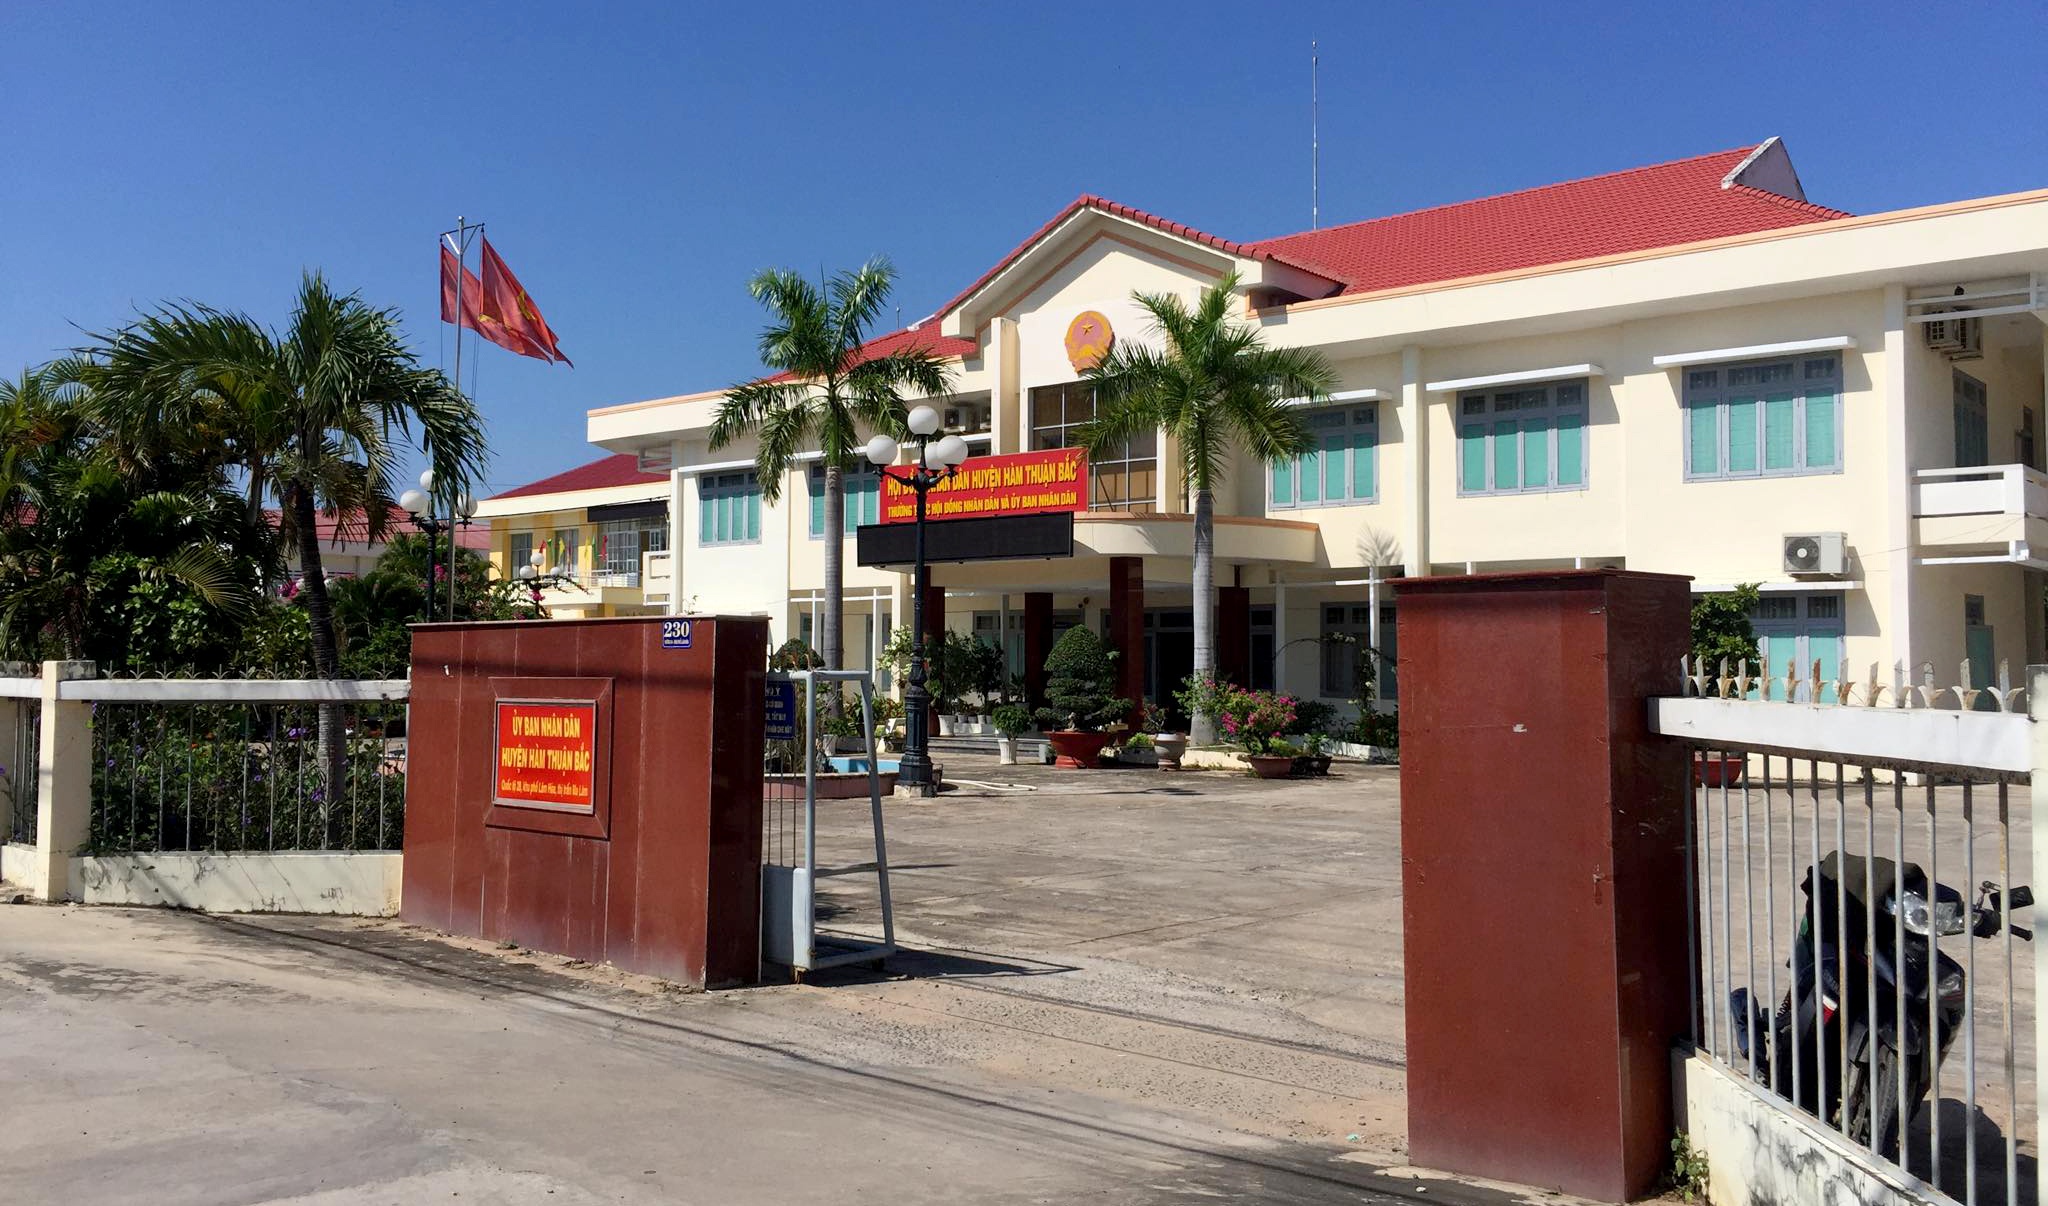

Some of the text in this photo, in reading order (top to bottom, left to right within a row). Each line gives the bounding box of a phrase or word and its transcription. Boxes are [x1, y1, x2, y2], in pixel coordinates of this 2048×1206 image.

[972, 464, 1001, 492] HUYỆN
[1004, 462, 1023, 487] HÀM
[1025, 459, 1056, 488] THUẬN
[1058, 453, 1077, 482] BẮC
[888, 502, 912, 518] THƯỜNG
[931, 500, 943, 518] HỘI
[944, 497, 962, 515] ĐỒNG
[964, 497, 983, 512] NHÂN
[984, 496, 999, 511] DÂN
[1001, 494, 1009, 509] VÀ
[1022, 495, 1037, 508] BAN
[1039, 491, 1060, 508] NHÂN
[1061, 489, 1077, 506] DÂN
[664, 621, 689, 638] 230
[512, 709, 580, 738] ỦY BAN NHÂN DÂN
[501, 742, 590, 777] HUYỆN HÀM THUẬN BẮC
